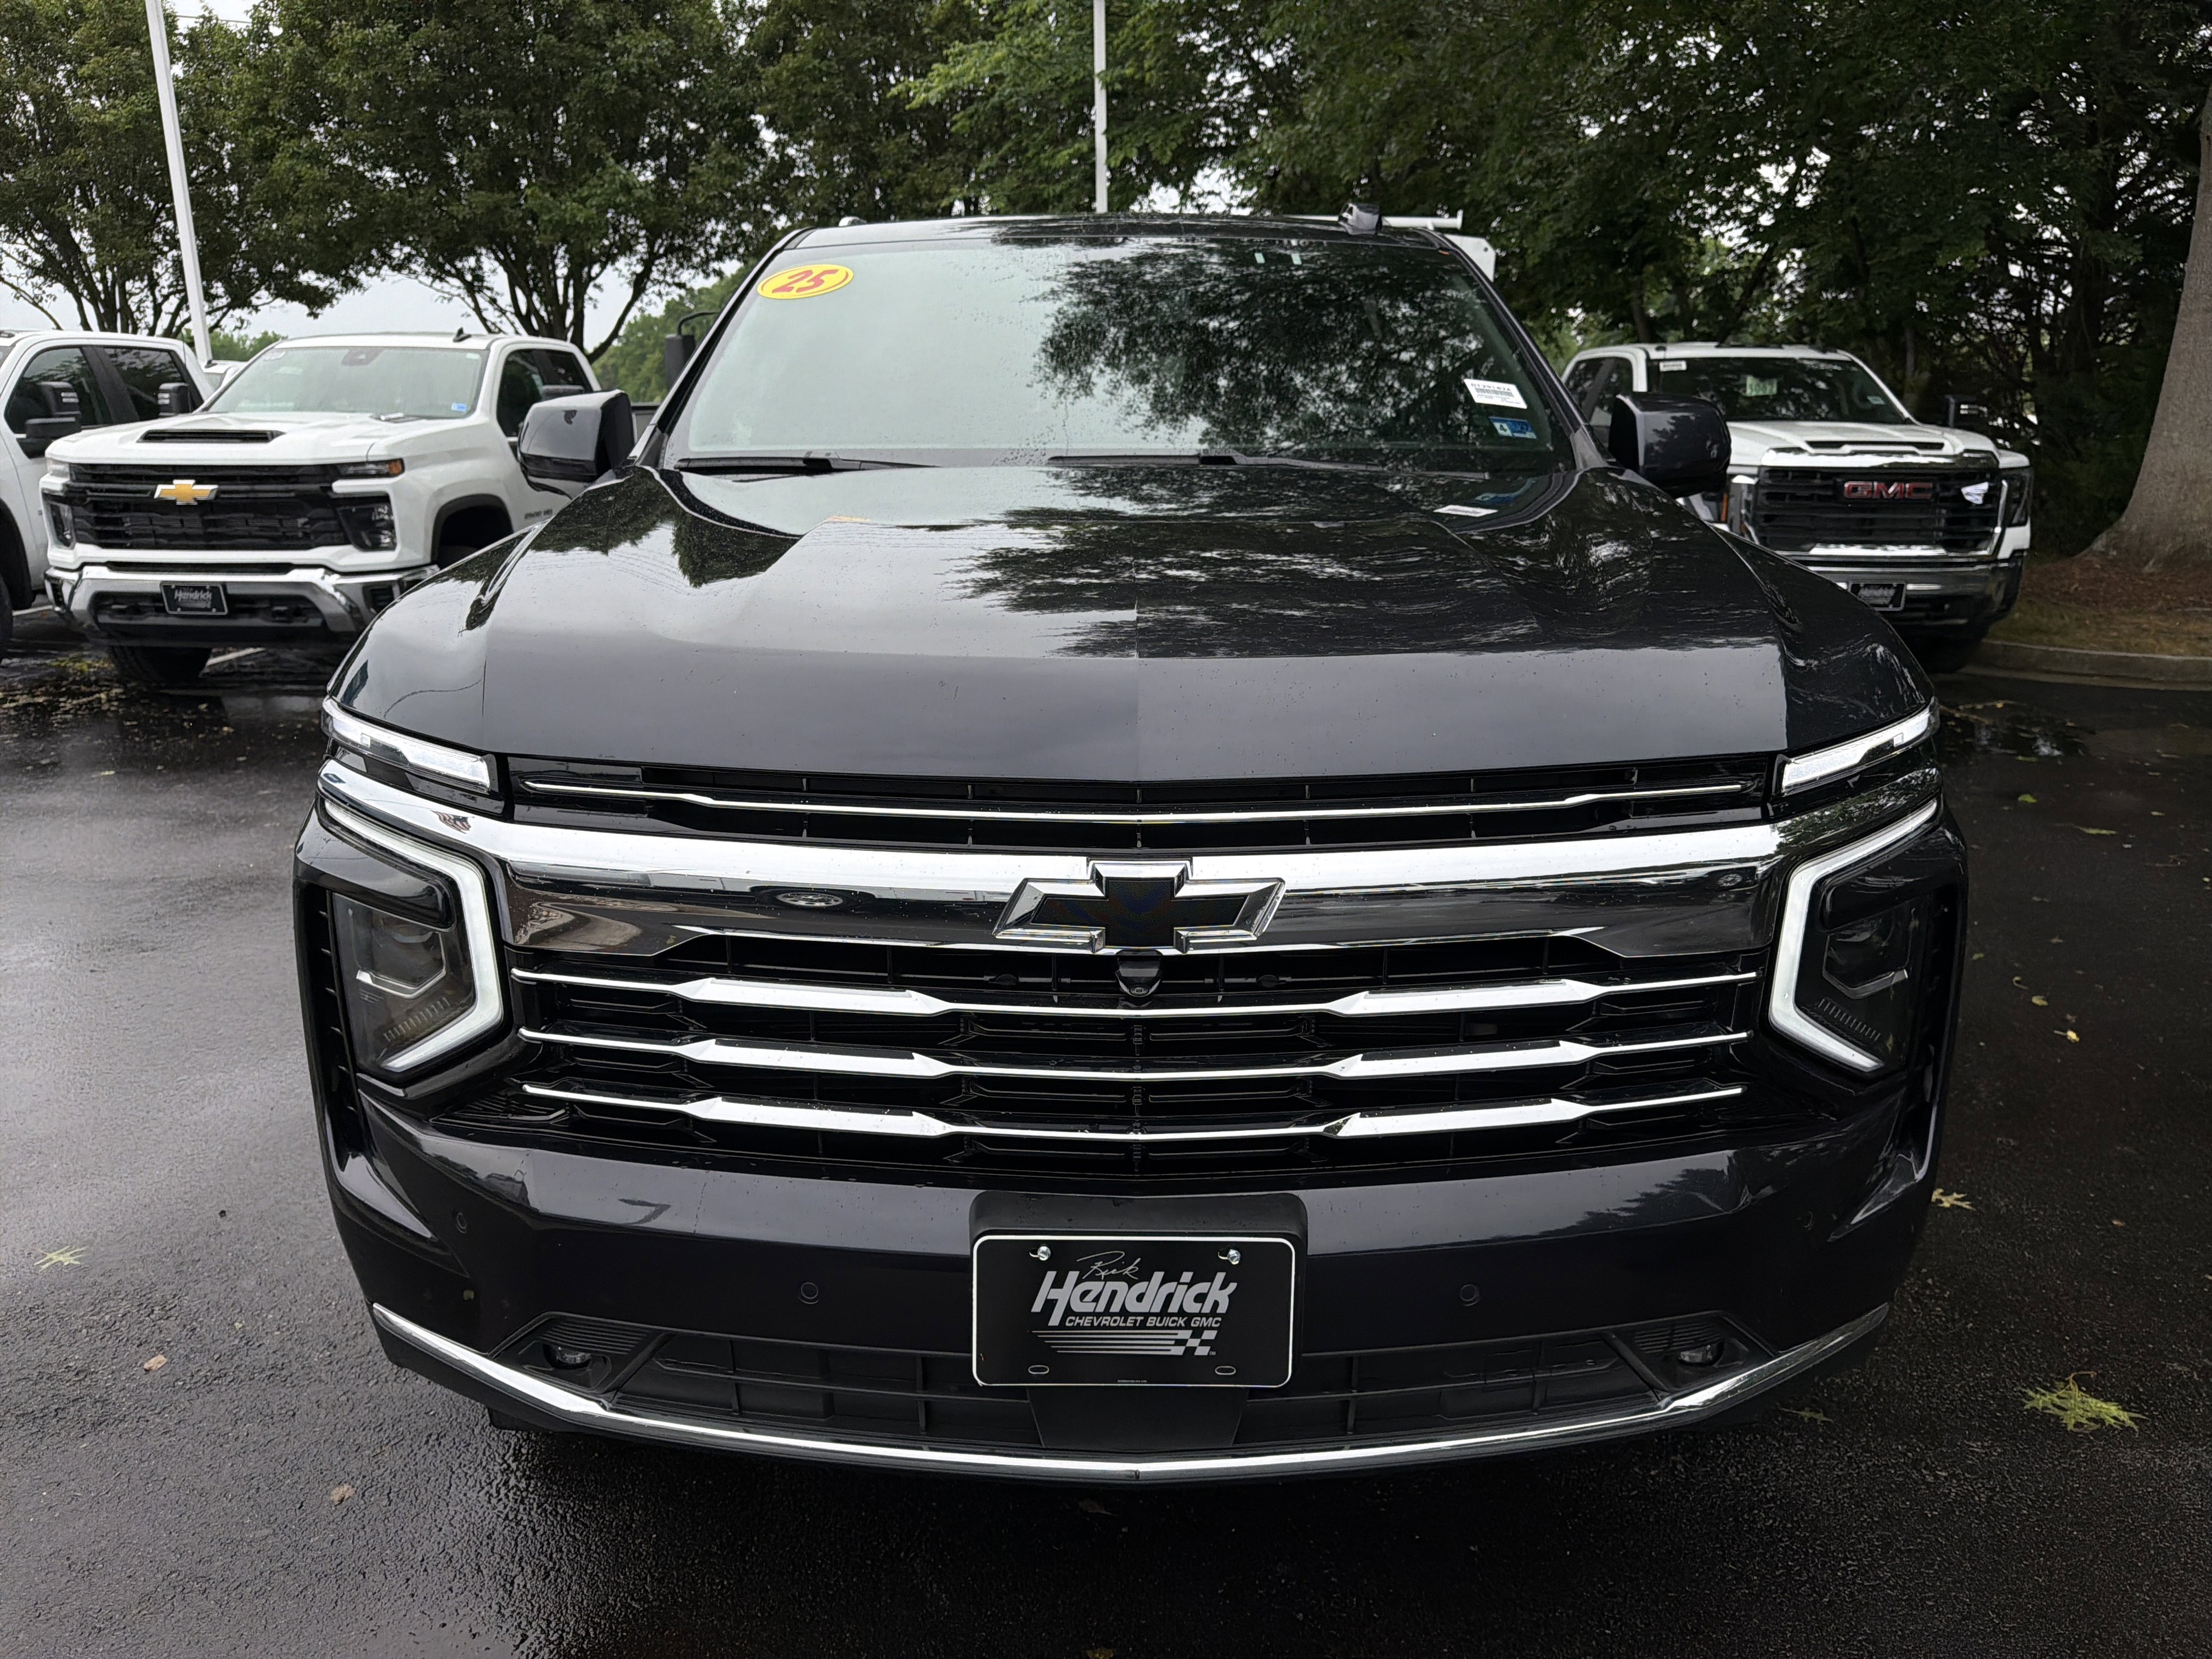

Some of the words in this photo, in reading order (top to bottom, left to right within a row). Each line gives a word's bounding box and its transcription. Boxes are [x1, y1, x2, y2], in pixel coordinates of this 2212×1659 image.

[771, 269, 840, 294] 25
[1499, 424, 1508, 433] 4
[1843, 481, 1933, 500] GMC
[1030, 1271, 1238, 1327] Hendrick
[1065, 1316, 1144, 1327] CHEVROLET
[1146, 1317, 1188, 1328] BUICK
[1190, 1317, 1222, 1328] GMC
